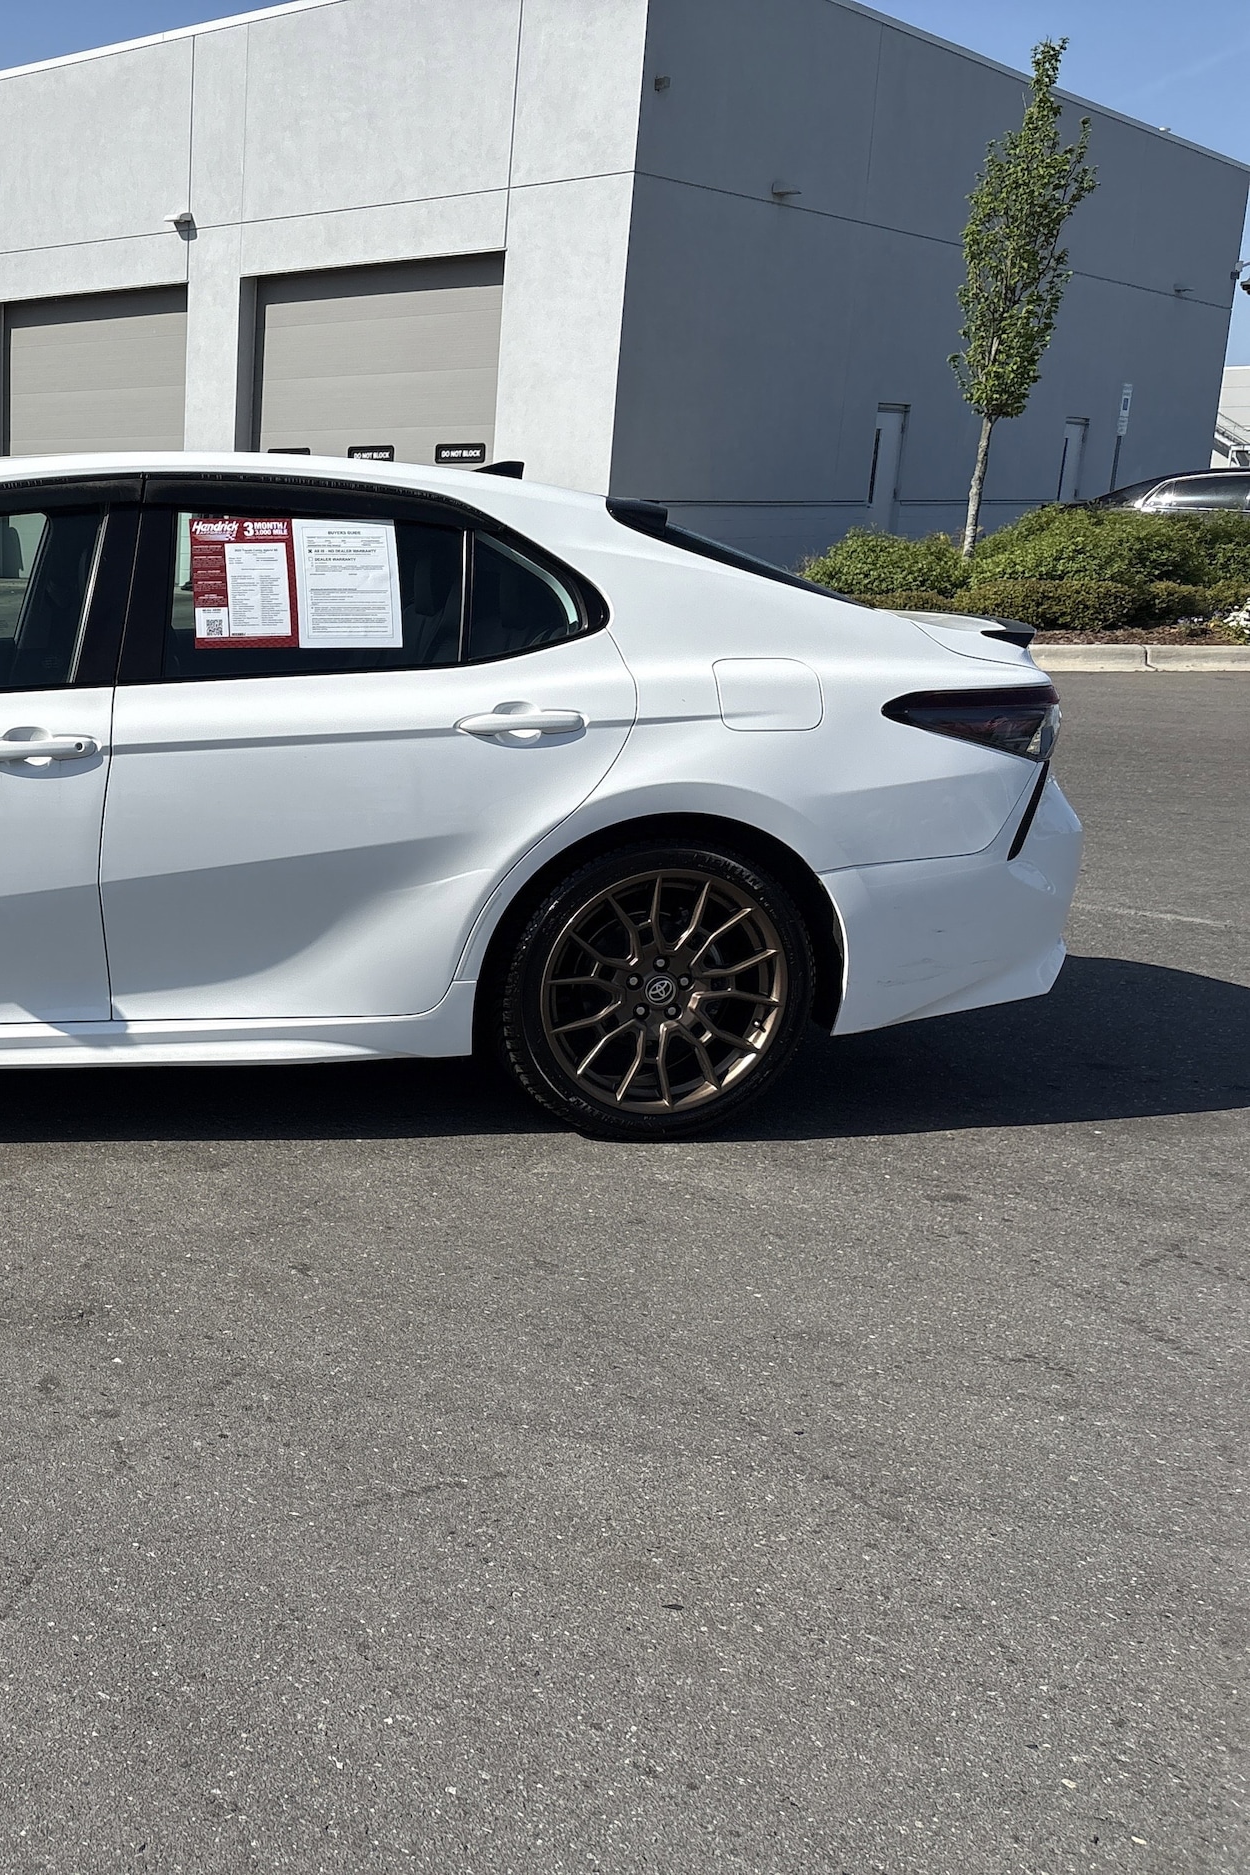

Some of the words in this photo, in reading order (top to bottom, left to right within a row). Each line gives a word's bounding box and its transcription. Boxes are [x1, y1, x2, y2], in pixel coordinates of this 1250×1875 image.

[192, 521, 239, 535] Hendrick
[243, 521, 254, 536] 3
[254, 522, 287, 530] MONTH/
